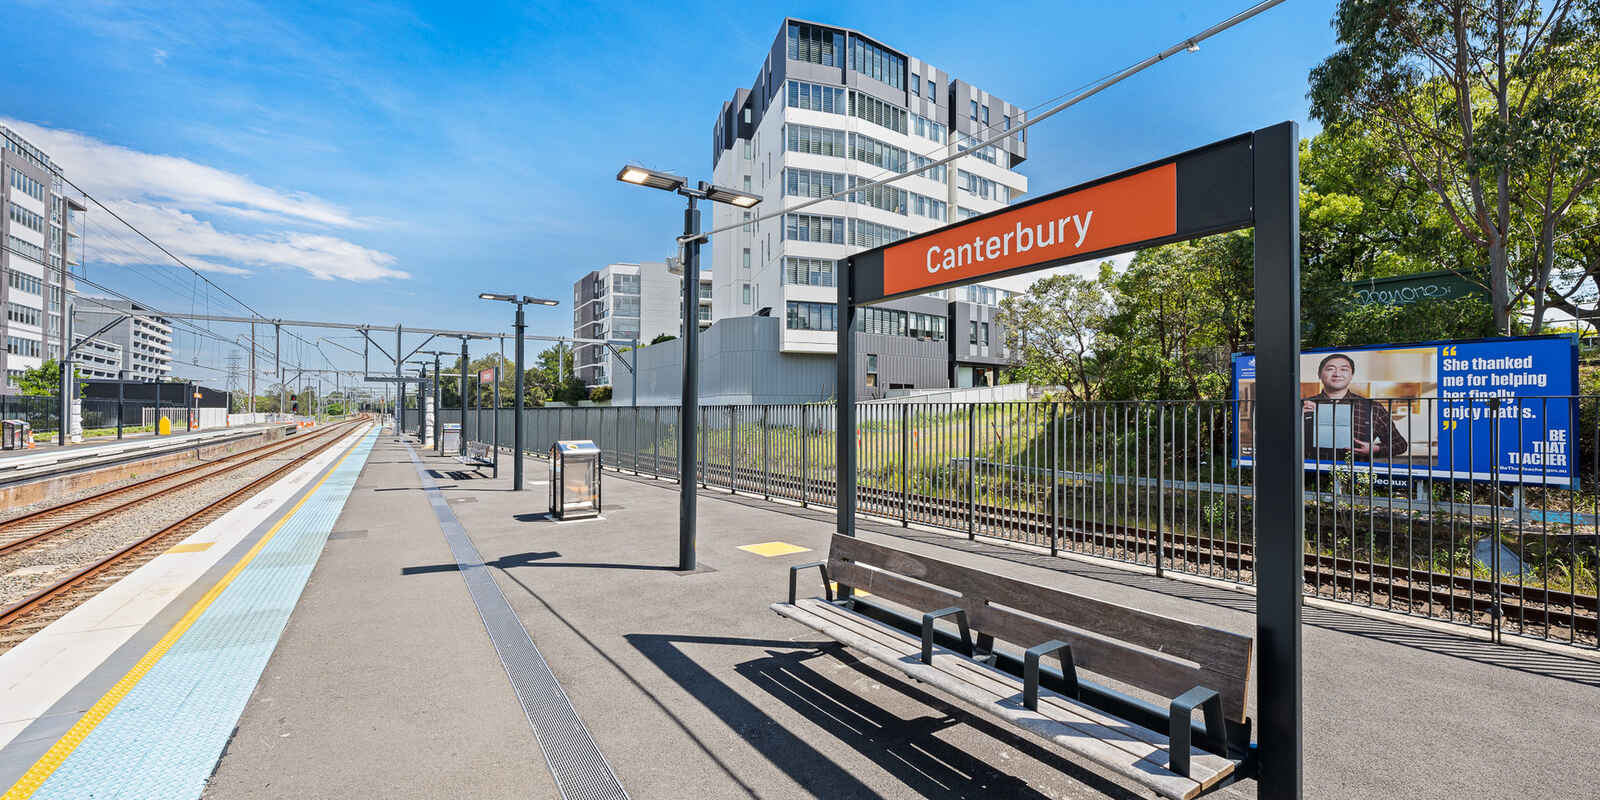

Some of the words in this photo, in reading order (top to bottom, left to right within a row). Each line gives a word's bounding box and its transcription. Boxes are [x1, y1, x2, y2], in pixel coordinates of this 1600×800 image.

[926, 210, 1094, 274] Canterbury
[1443, 359, 1468, 371] She
[1472, 356, 1532, 370] thanked
[1443, 376, 1463, 387] me
[1467, 374, 1488, 386] for
[1491, 372, 1547, 387] helping
[1443, 390, 1466, 402] her
[1469, 389, 1515, 404] finally
[1443, 406, 1480, 420] enjoy
[1549, 429, 1566, 441] BE
[1532, 441, 1567, 453] THAT
